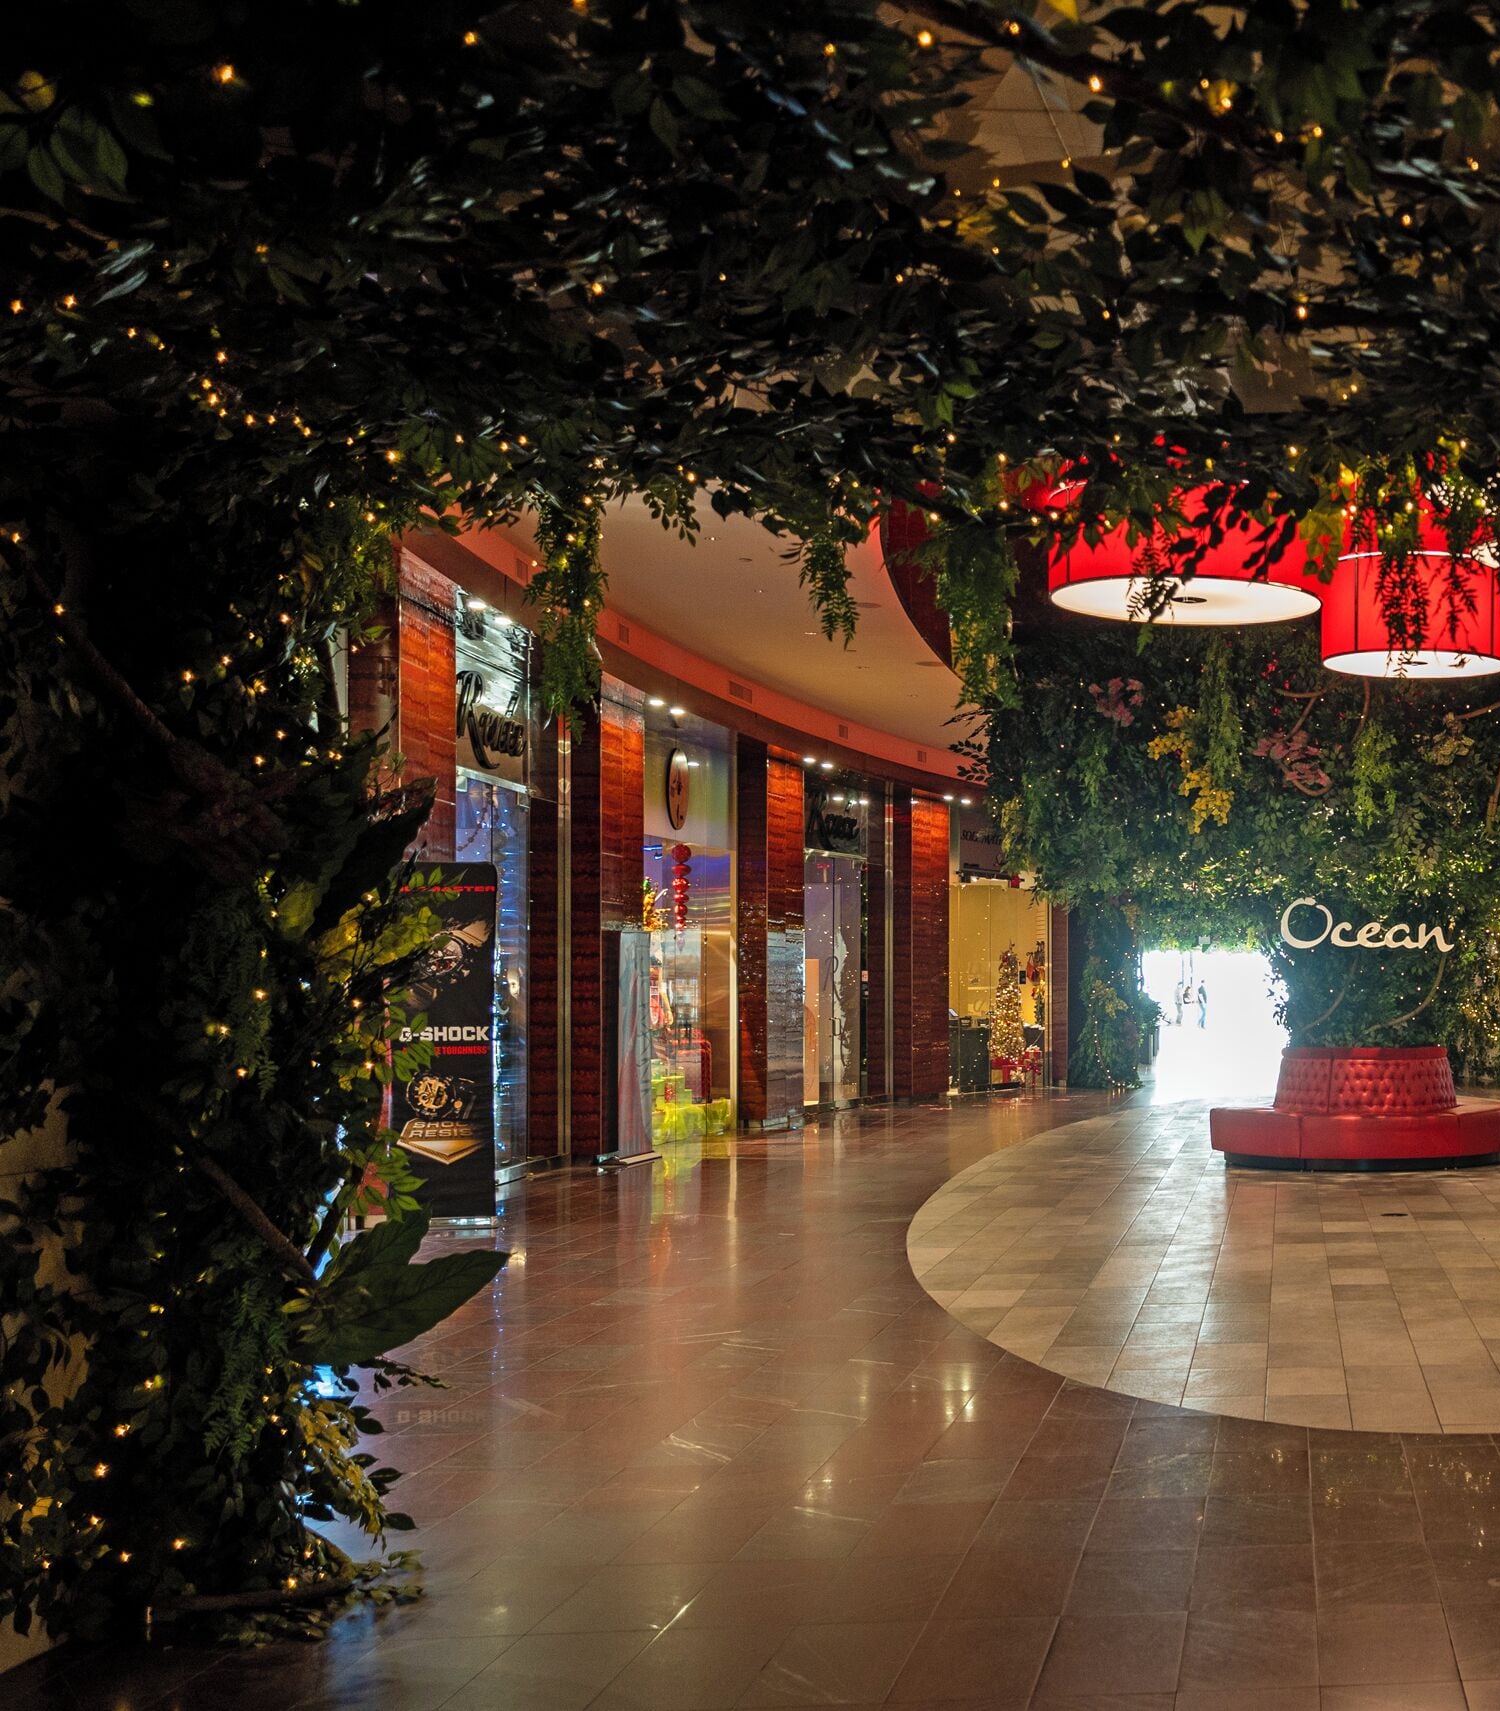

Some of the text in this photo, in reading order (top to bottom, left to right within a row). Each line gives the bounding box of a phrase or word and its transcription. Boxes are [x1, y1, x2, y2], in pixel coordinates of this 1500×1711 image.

[1280, 897, 1455, 953] Ocean
[399, 1026, 490, 1042] G-SHOCK
[442, 1045, 488, 1055] TOUGHNESS
